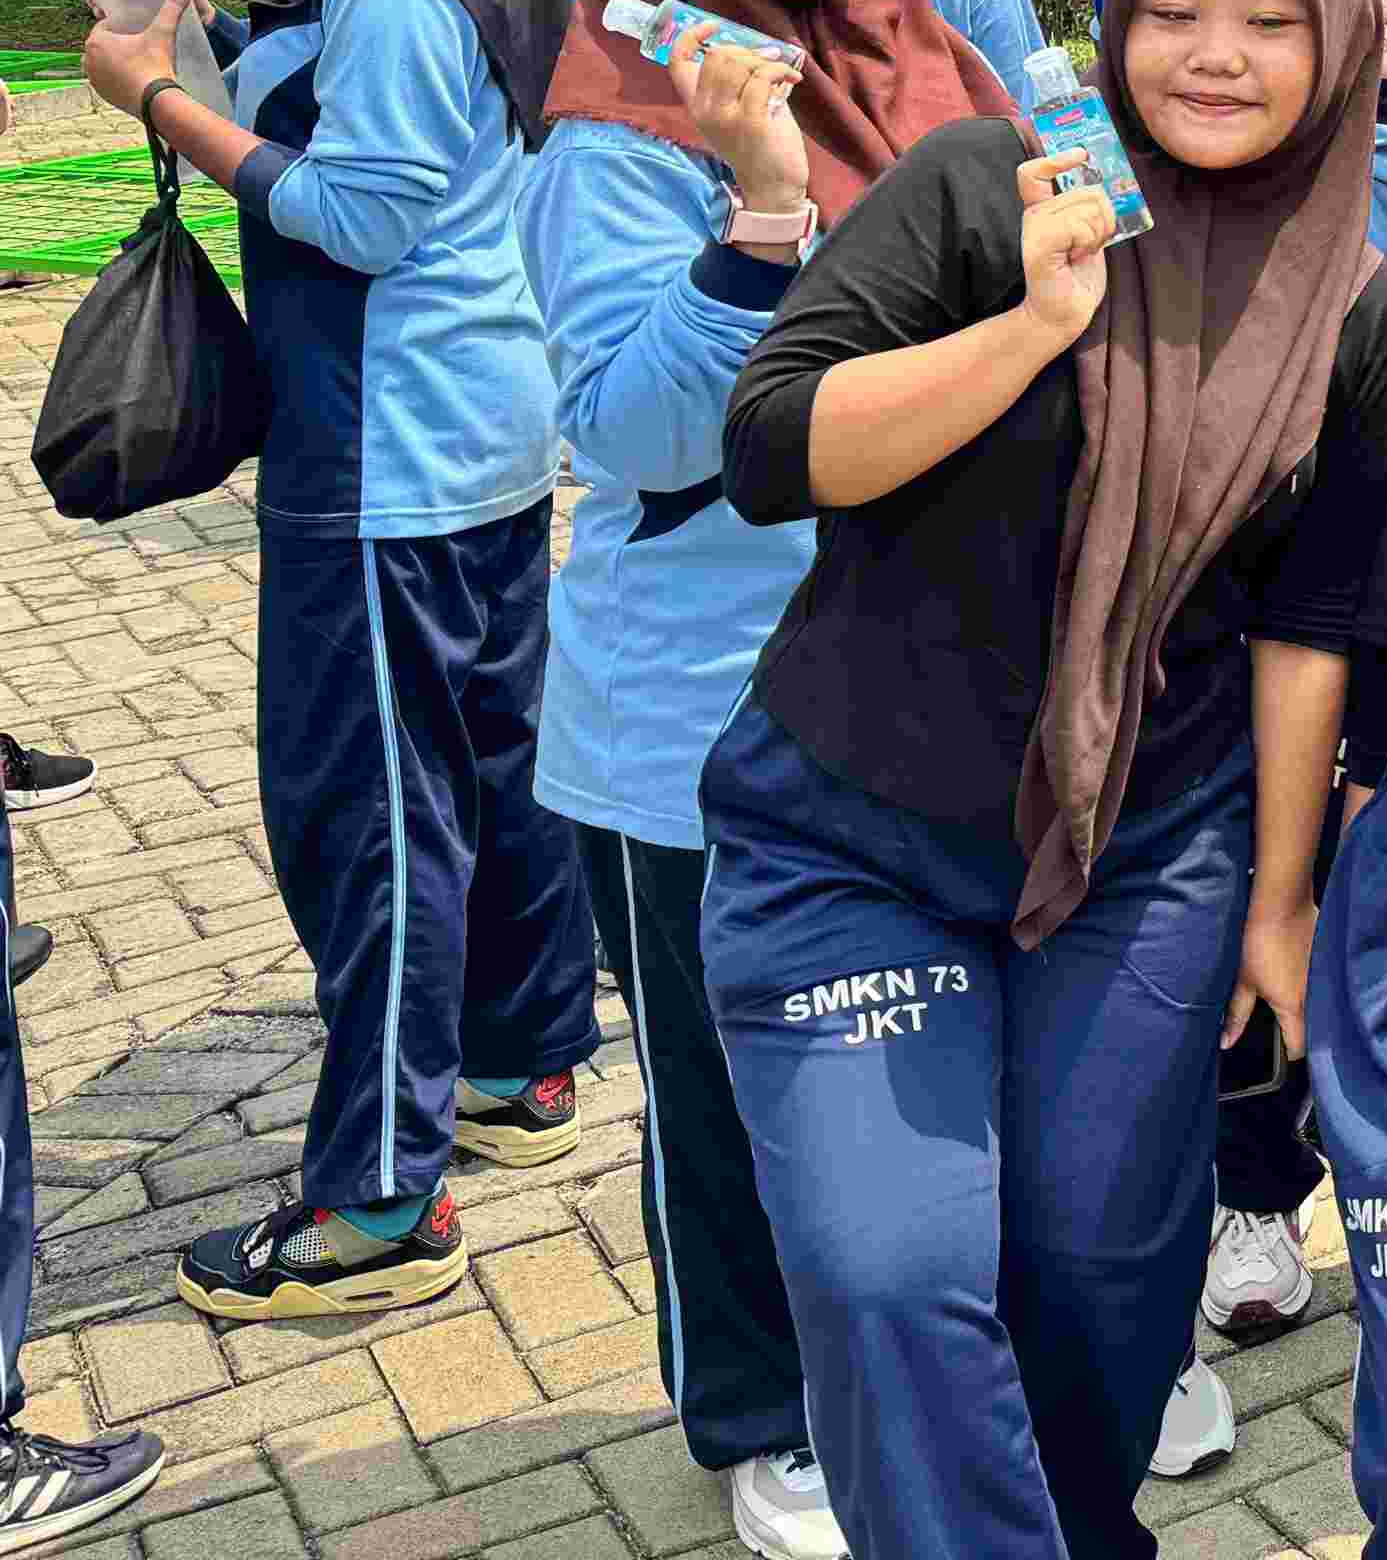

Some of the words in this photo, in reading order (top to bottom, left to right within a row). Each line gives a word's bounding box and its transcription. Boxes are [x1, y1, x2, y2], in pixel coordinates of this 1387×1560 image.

[783, 968, 916, 1023] SMKN
[927, 965, 969, 993] 73
[844, 1002, 928, 1045] JKT
